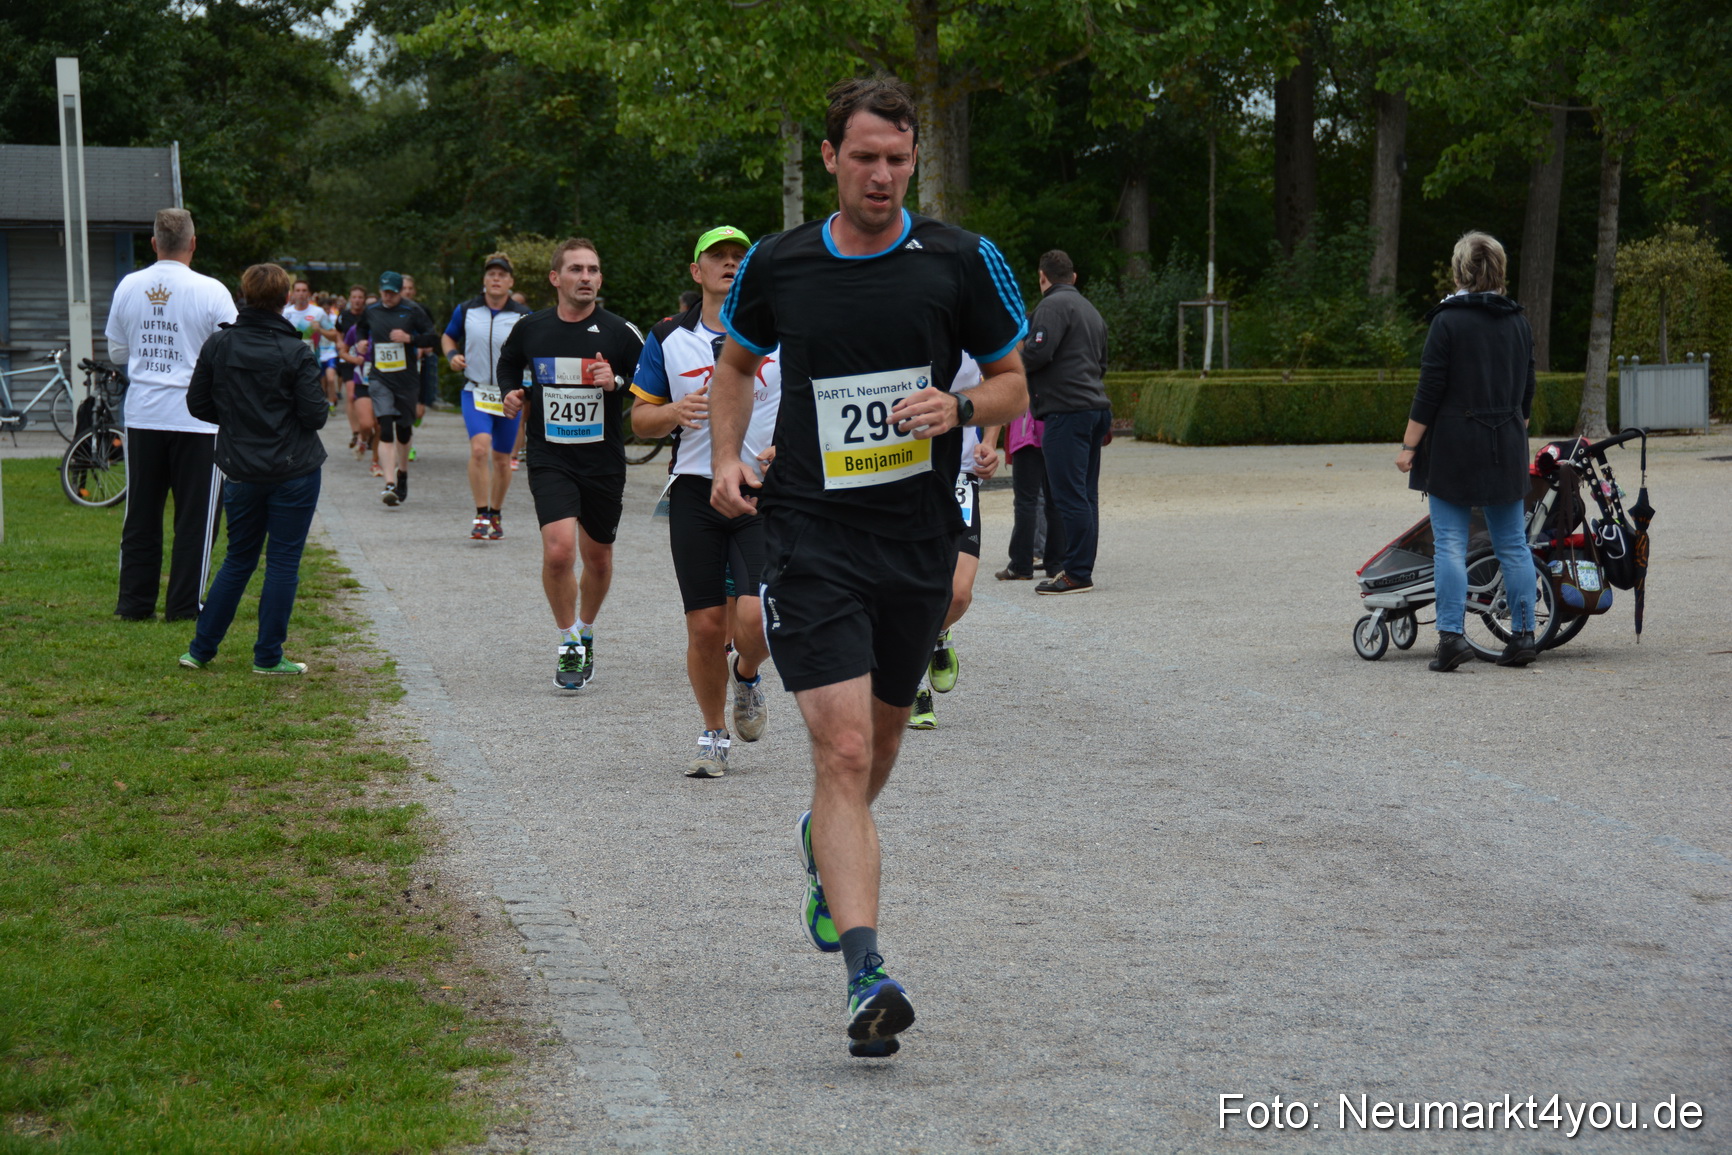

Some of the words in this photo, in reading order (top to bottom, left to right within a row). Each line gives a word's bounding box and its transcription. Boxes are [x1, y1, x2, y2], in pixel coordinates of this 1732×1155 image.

[153, 306, 164, 316] IM
[141, 334, 174, 346] SEINER
[380, 350, 399, 361] 361
[145, 361, 172, 374] JESUS
[817, 388, 854, 401] PARTL
[857, 381, 913, 396] Neumarkt
[549, 401, 599, 422] 2497
[556, 426, 591, 436] Thorsten
[845, 448, 913, 472] Benjamin
